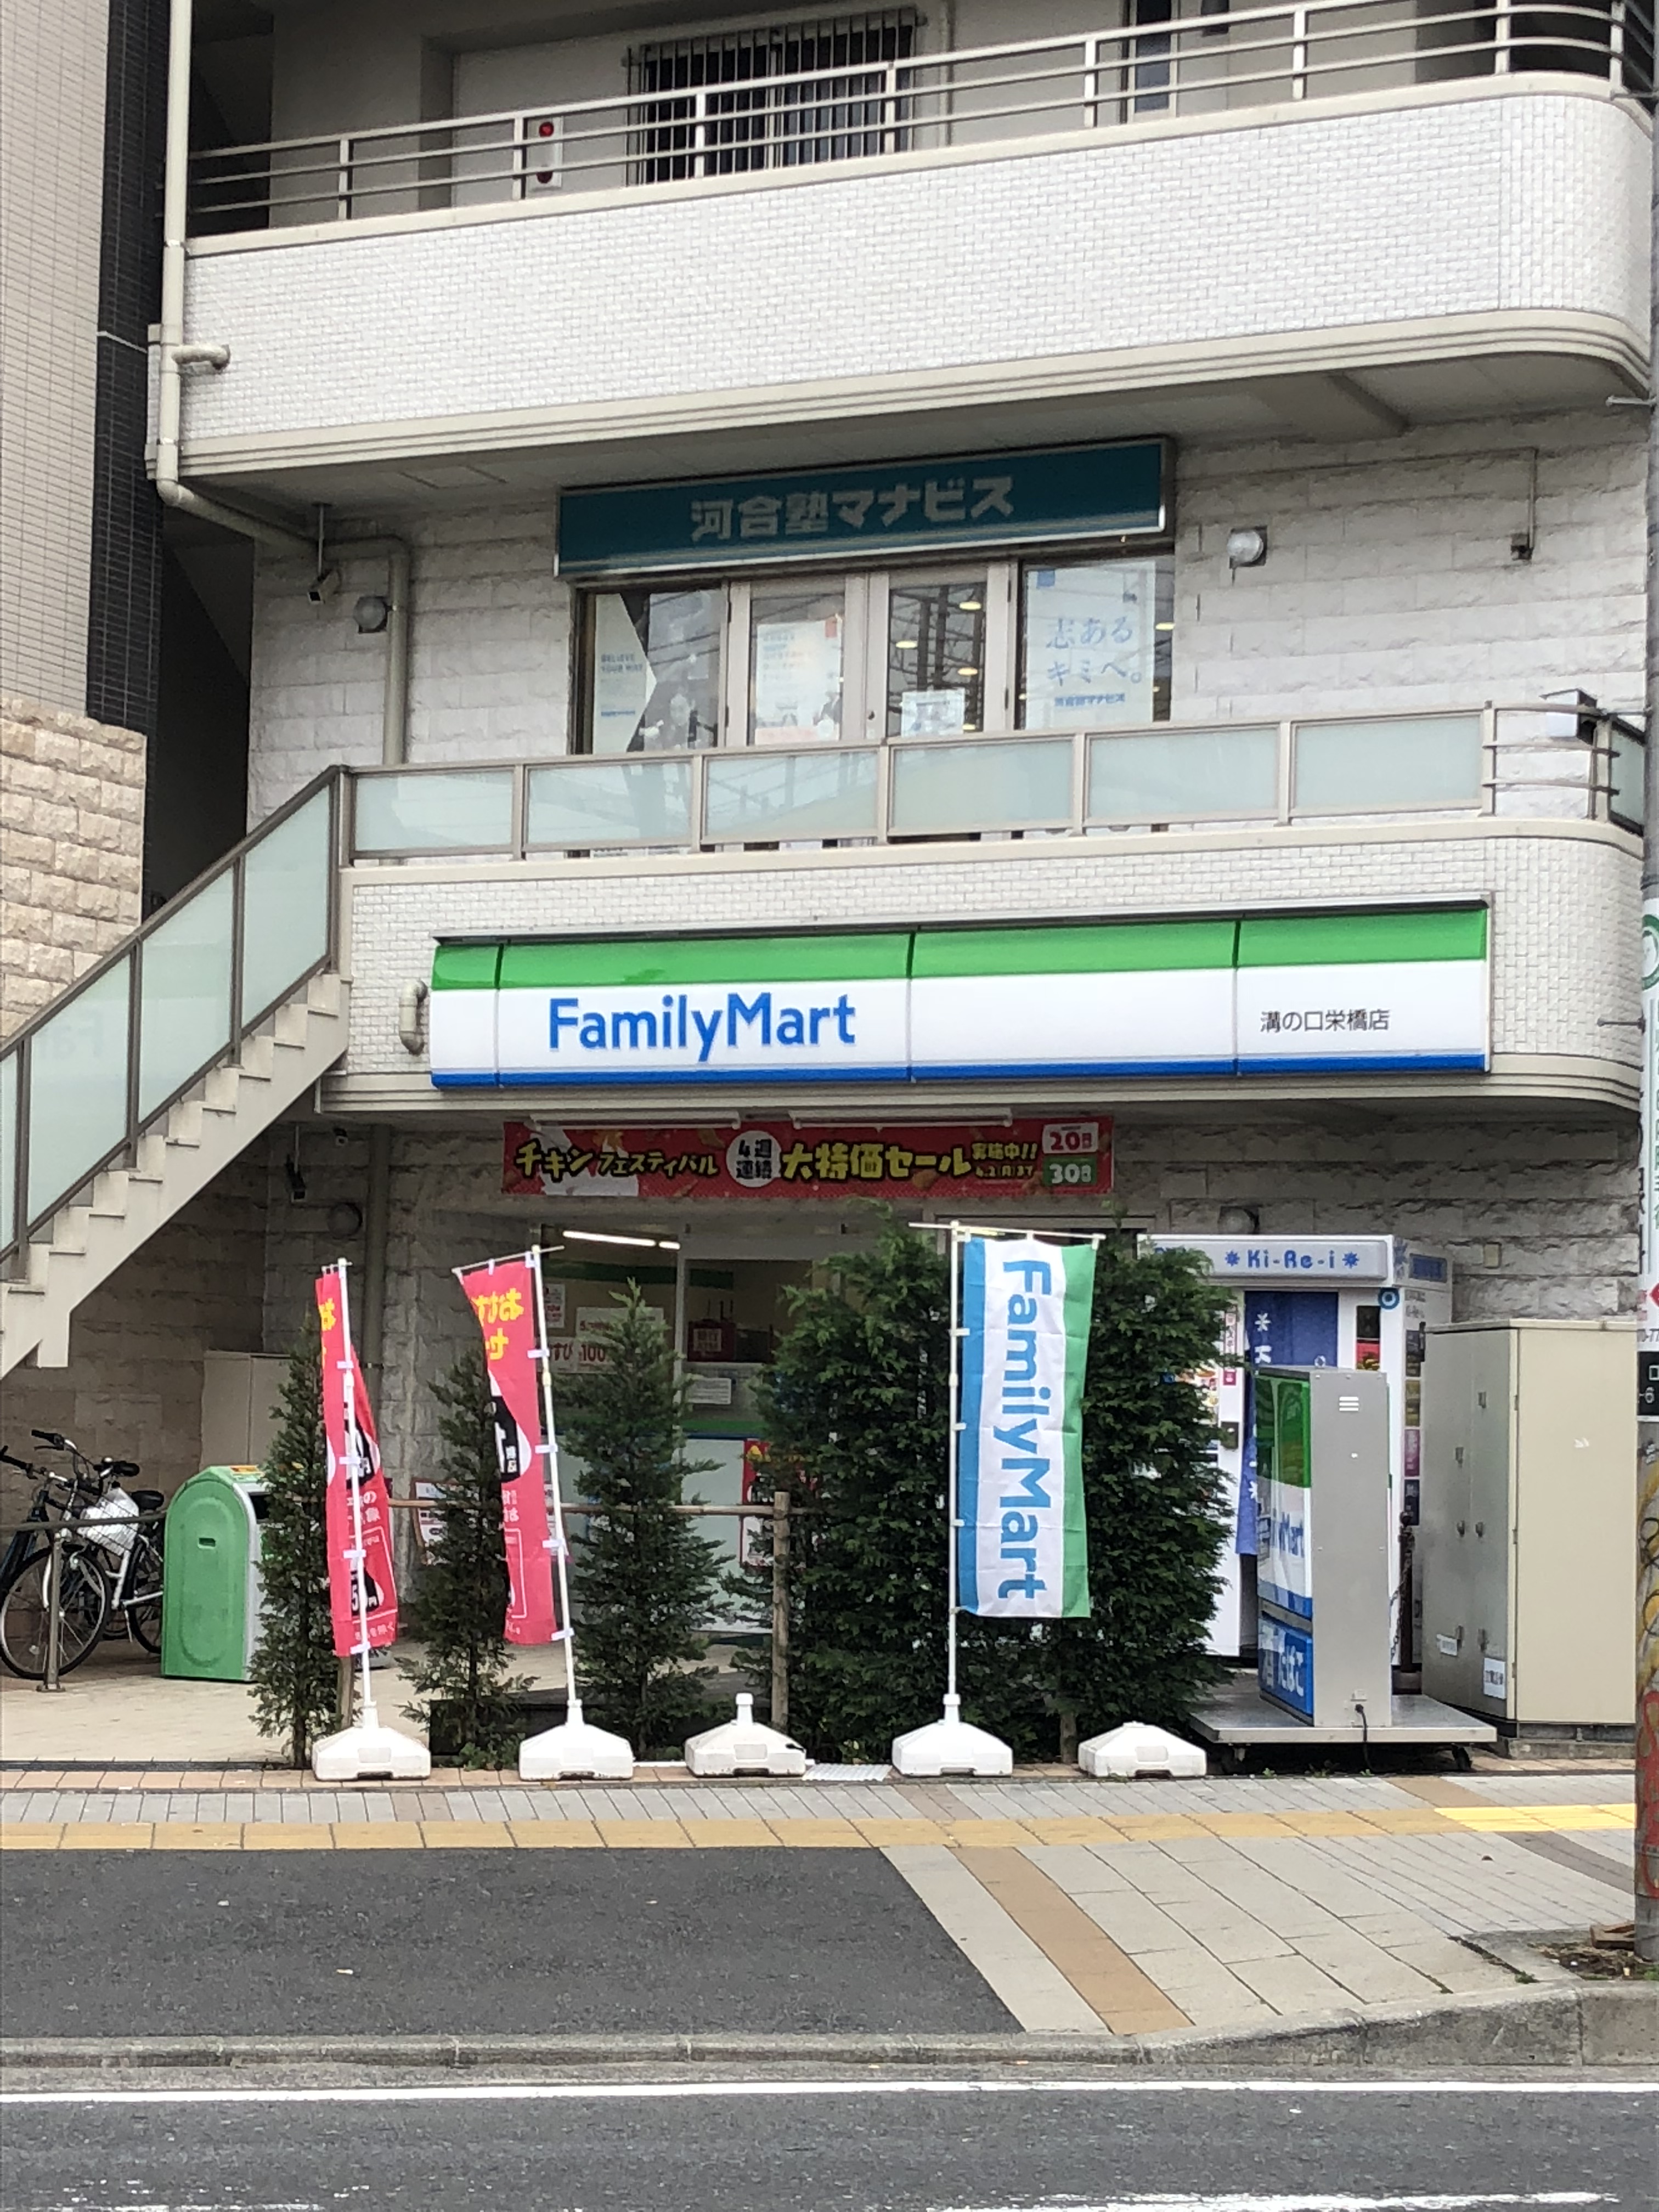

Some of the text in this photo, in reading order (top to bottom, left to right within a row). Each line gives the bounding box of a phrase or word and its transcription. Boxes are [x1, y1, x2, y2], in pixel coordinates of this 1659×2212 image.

[691, 476, 1014, 543] 河合塾マナビス
[1046, 616, 1132, 650] 志ある
[549, 991, 856, 1063] FamilyMart
[1260, 1008, 1391, 1034] 溝の口栄橋店
[781, 1142, 972, 1180] 大特価セール
[993, 1260, 1052, 1600] FamilyMart
